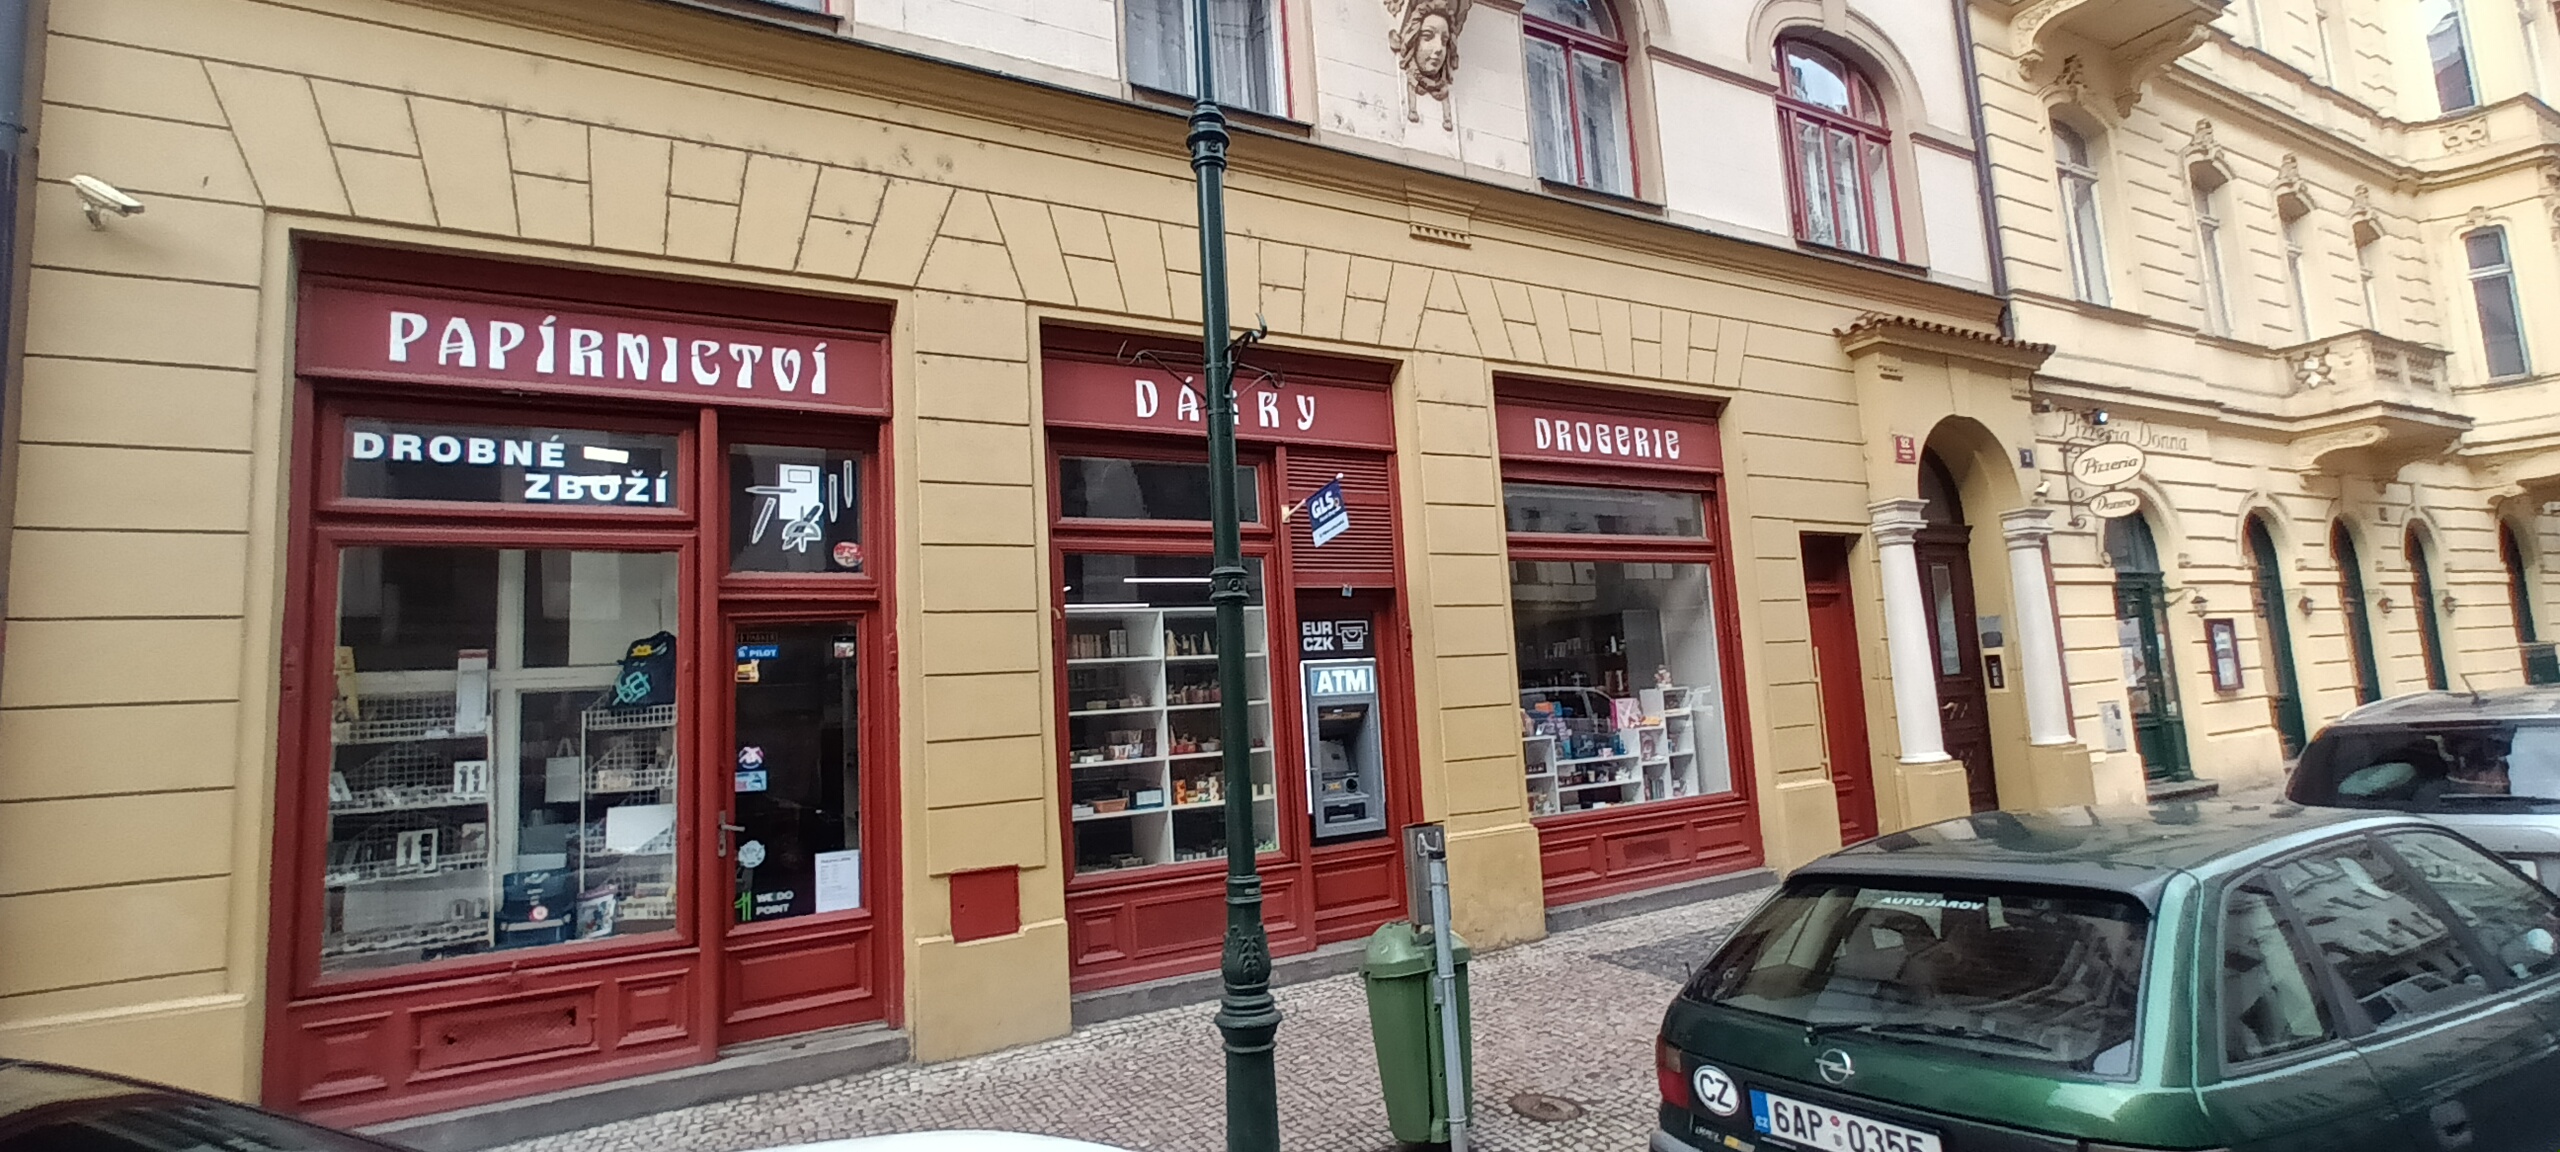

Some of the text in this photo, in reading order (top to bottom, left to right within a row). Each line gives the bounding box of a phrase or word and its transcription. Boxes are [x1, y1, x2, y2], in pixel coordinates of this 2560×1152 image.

[388, 310, 828, 394] PAPÍRNICTVÍ
[1135, 376, 1316, 430] DÁKY
[352, 432, 566, 468] DROBNÉ
[1534, 417, 1680, 459] DROGERIE
[2138, 421, 2188, 452] Donna
[2081, 456, 2138, 476] Pizzeria
[524, 470, 667, 502] ZBOŽÍ
[1311, 491, 1335, 519] GLS
[2096, 495, 2137, 512] Donna
[1302, 621, 1333, 636] EUR
[749, 649, 777, 657] PILOT
[1303, 636, 1335, 651] CZK
[1317, 668, 1368, 693] ATM
[756, 903, 790, 915] POINT
[1700, 1073, 1732, 1109] CZ
[1773, 1101, 1823, 1141] 6AP
